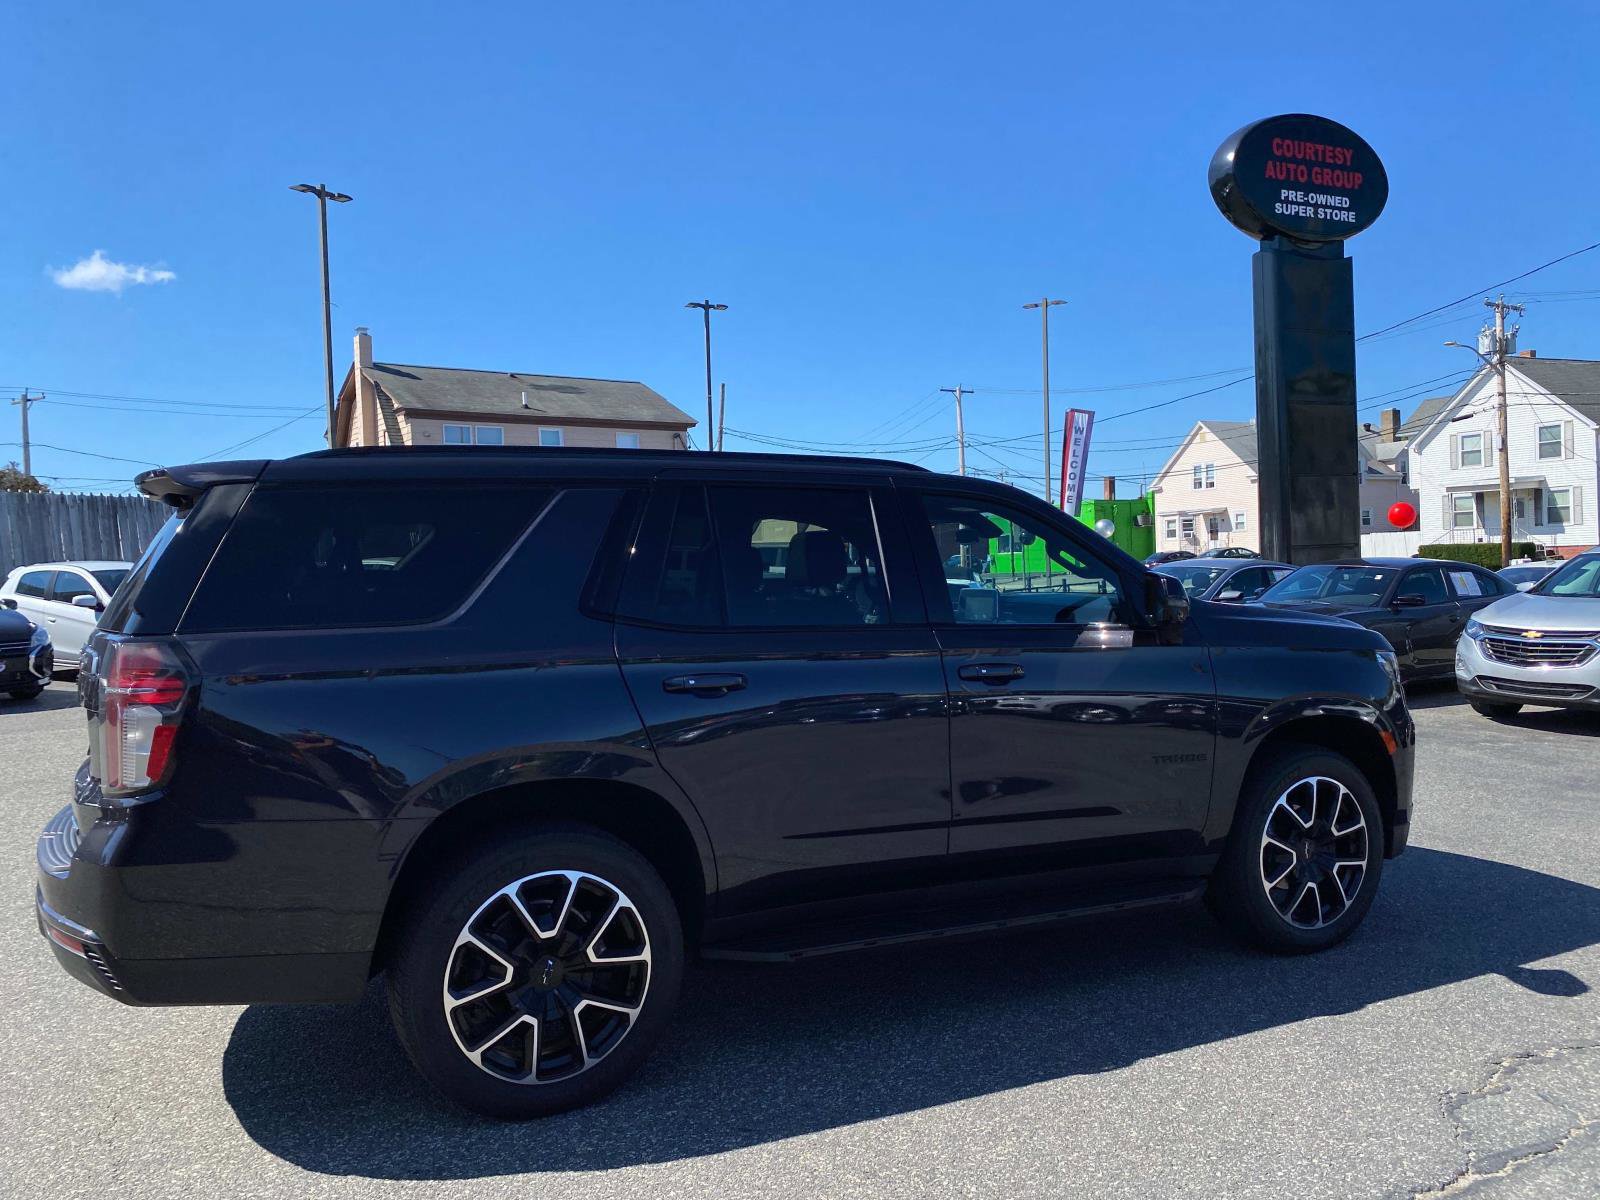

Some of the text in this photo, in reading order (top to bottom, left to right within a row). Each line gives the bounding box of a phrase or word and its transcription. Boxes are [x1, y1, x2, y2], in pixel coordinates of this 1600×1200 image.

[1273, 138, 1352, 166] COURTESY
[1265, 161, 1362, 189] AUTO GROUP
[1281, 189, 1350, 208] PRE-OWNED
[1275, 202, 1356, 223] SUPER STORE
[1067, 426, 1084, 503] WELCOME
[1152, 753, 1208, 764] TAHOE
